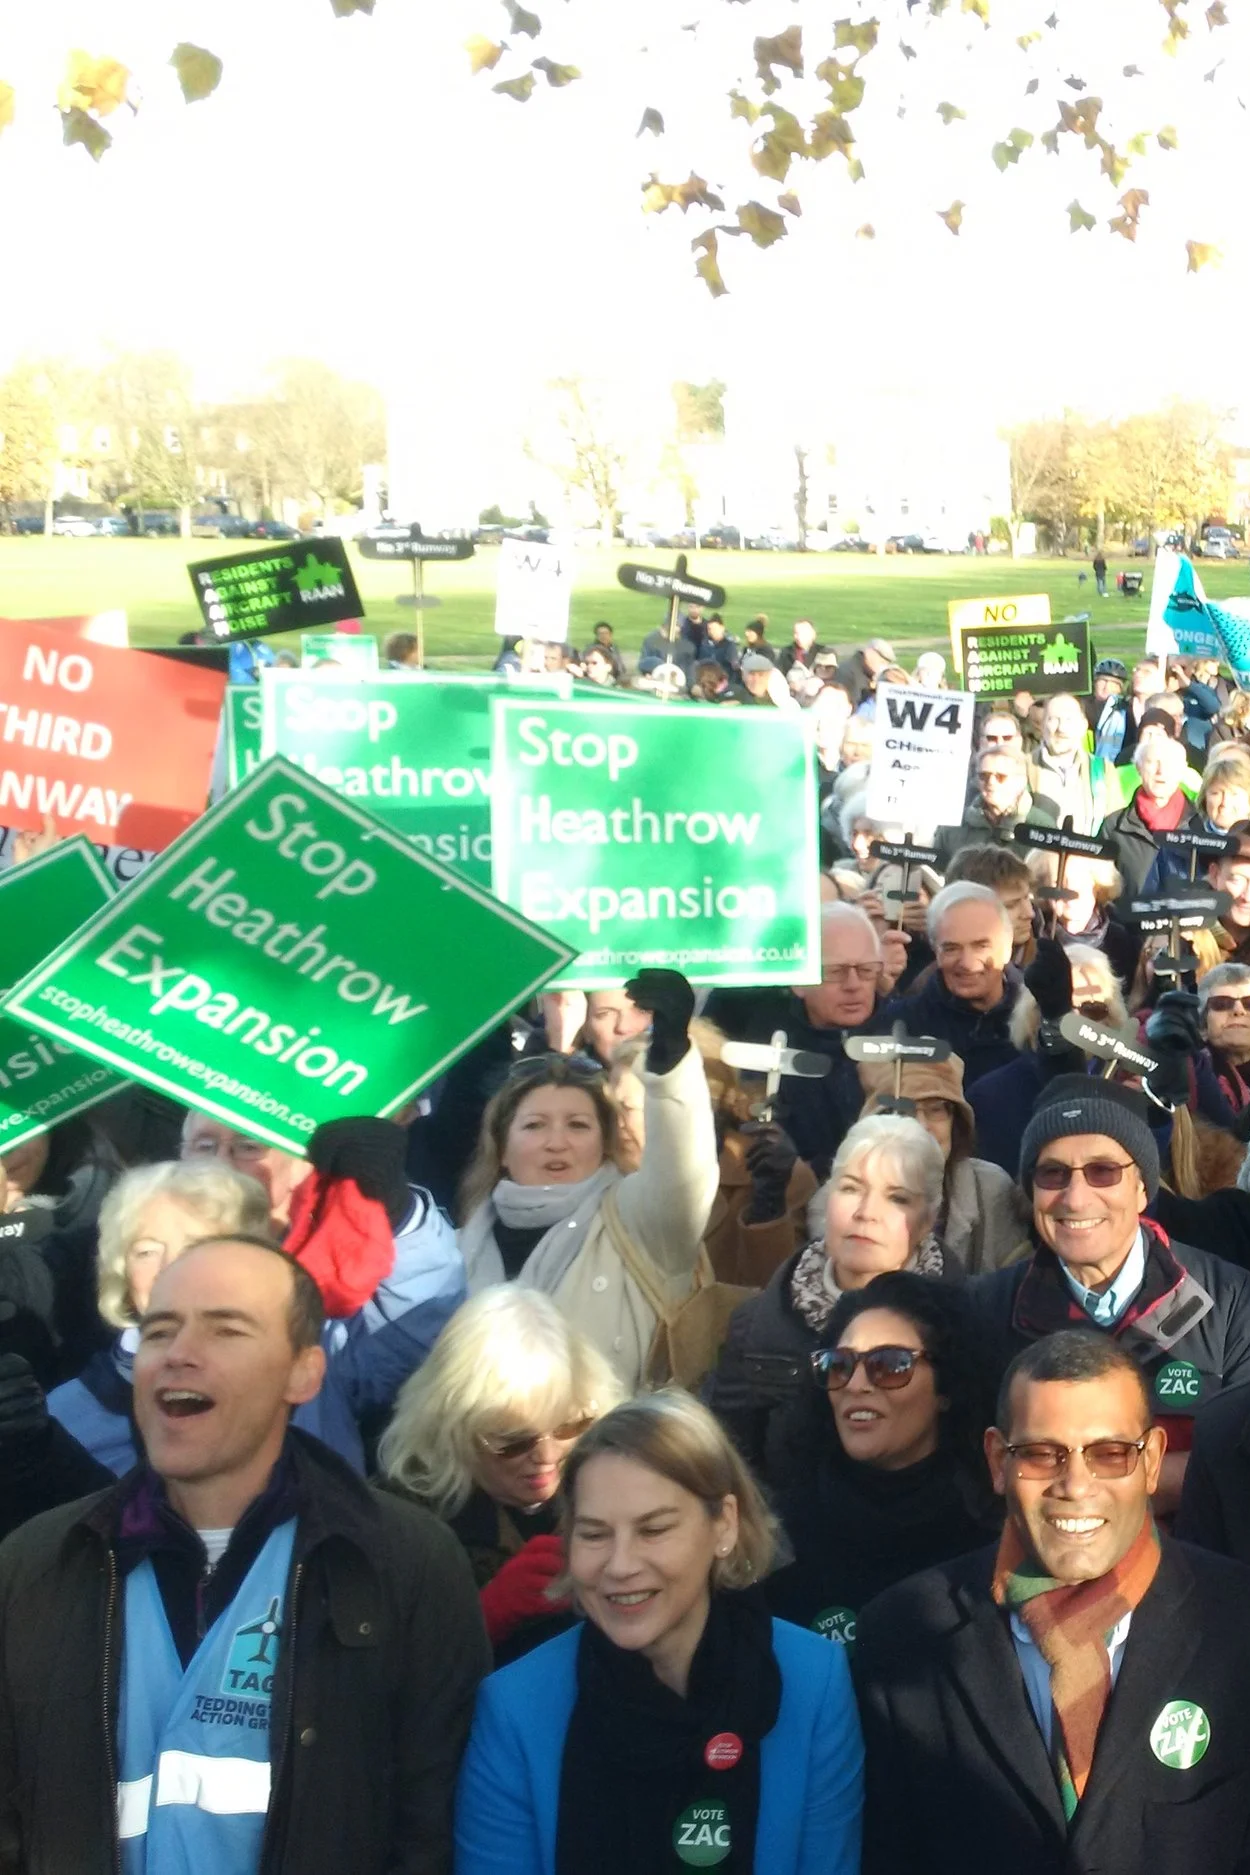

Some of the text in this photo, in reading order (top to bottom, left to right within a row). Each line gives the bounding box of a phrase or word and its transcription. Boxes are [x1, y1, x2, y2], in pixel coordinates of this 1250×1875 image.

[300, 583, 345, 603] RAAN
[984, 604, 1017, 622] NO
[967, 632, 1046, 649] RESIDENTS
[23, 644, 93, 692] NO
[967, 648, 1030, 664] AGAINST
[886, 698, 962, 735] W4
[518, 716, 638, 782] Stop
[521, 795, 761, 845] Heathrow
[245, 793, 377, 900] Stop
[1029, 829, 1045, 842] No
[1061, 836, 1103, 855] Runway
[1166, 833, 1179, 843] No
[1192, 835, 1227, 849] Runway
[520, 870, 777, 934] Expansion
[168, 856, 429, 1027] Heathrow
[94, 924, 369, 1096] Expansion
[1079, 1024, 1098, 1042] No
[1113, 1041, 1159, 1072] Runway
[1168, 1368, 1192, 1377] VOTE
[1160, 1379, 1198, 1395] ZAC
[818, 1612, 846, 1630] VOTE
[821, 1621, 856, 1645] AC
[191, 1709, 244, 1726] ACTION
[693, 1809, 724, 1820] VOTE
[678, 1823, 731, 1847] ZAC
